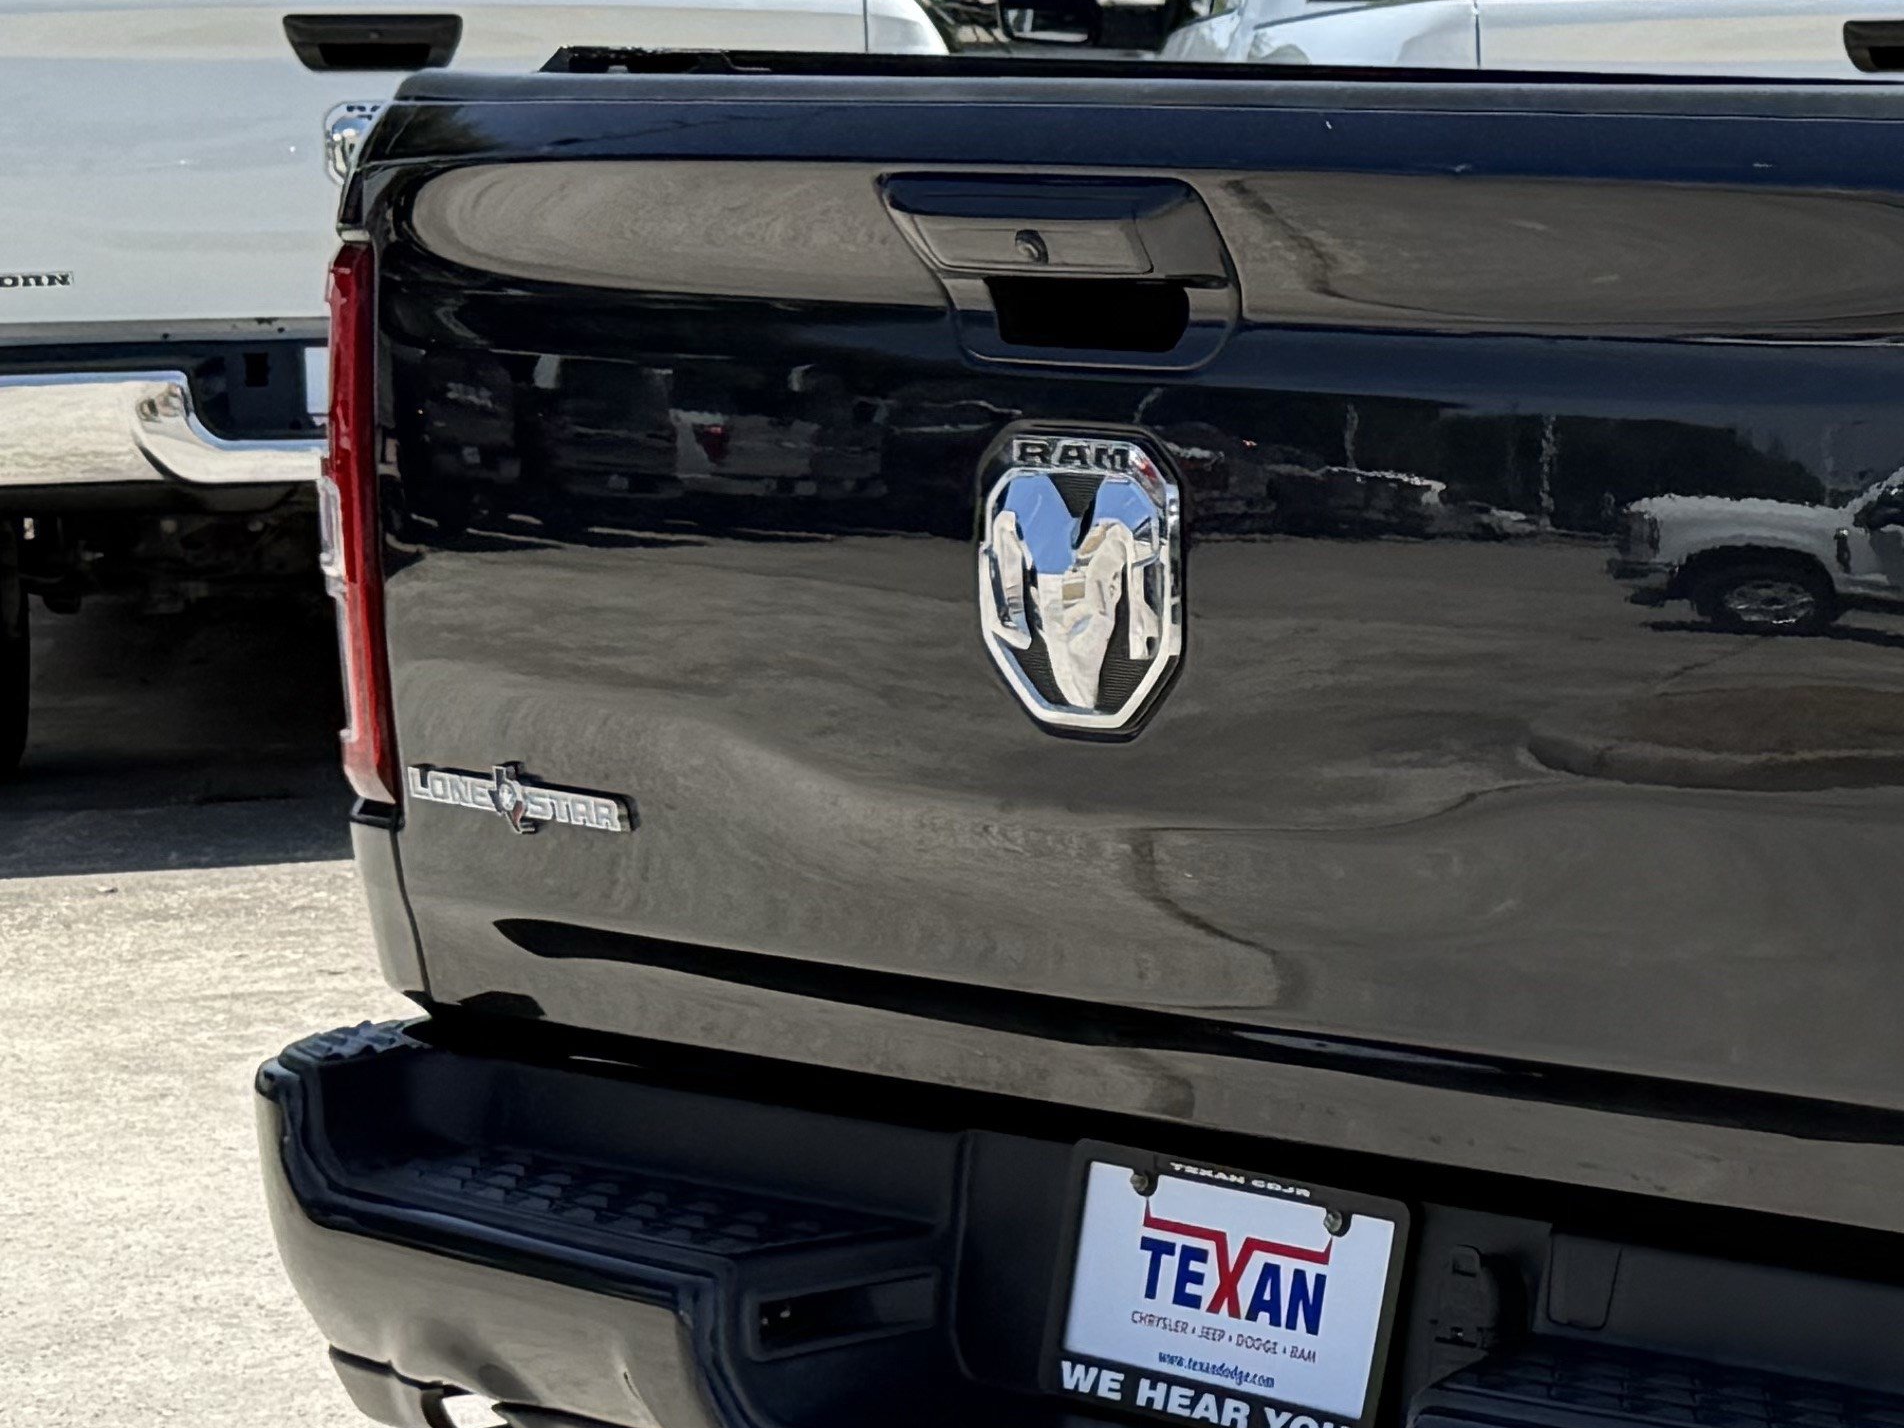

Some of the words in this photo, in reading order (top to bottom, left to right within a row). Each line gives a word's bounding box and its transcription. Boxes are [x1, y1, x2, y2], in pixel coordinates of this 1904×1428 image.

[1016, 439, 1131, 472] RAM
[407, 765, 498, 814] LONE
[523, 786, 622, 833] STAR
[1139, 1217, 1330, 1336] TEXAN
[1060, 1359, 1126, 1401] WE
